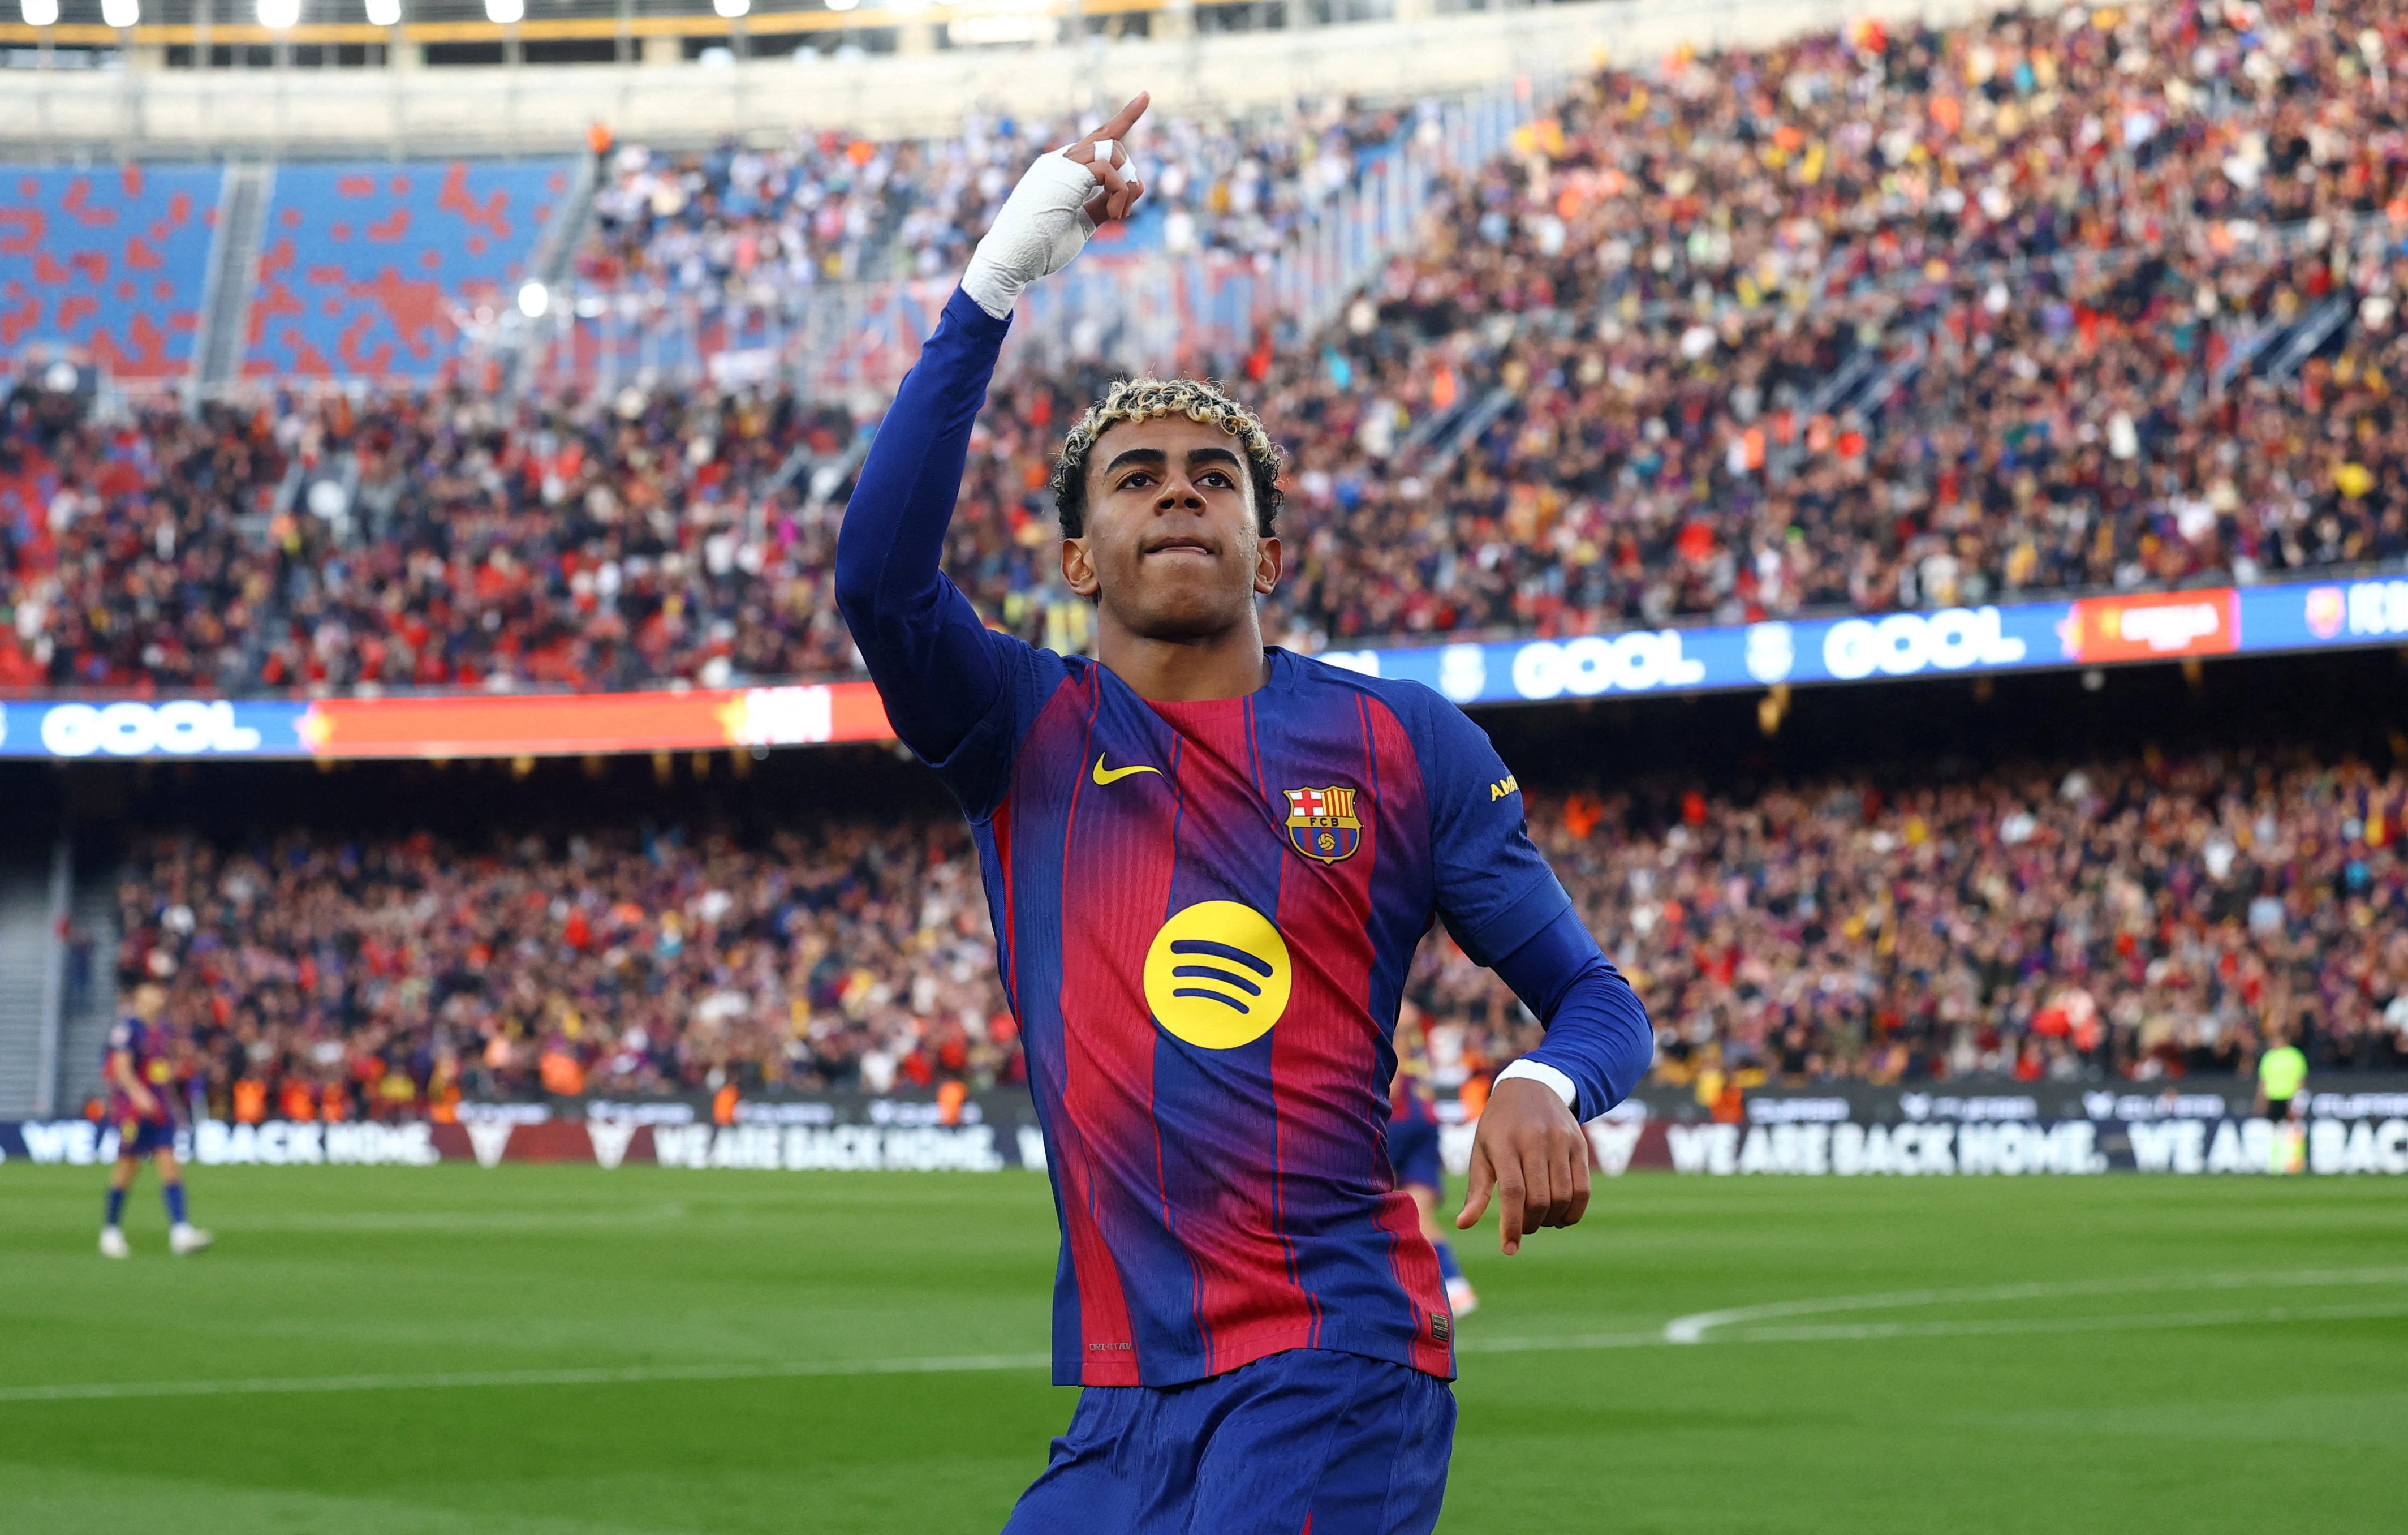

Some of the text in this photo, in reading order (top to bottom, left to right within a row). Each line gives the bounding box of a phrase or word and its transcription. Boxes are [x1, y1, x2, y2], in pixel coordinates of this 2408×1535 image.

[1513, 629, 1705, 699] GOOL
[1823, 605, 2026, 678] GOOL
[1309, 818, 1339, 827] FCB
[195, 1119, 324, 1165] BACK
[1832, 1121, 1956, 1176] BACK
